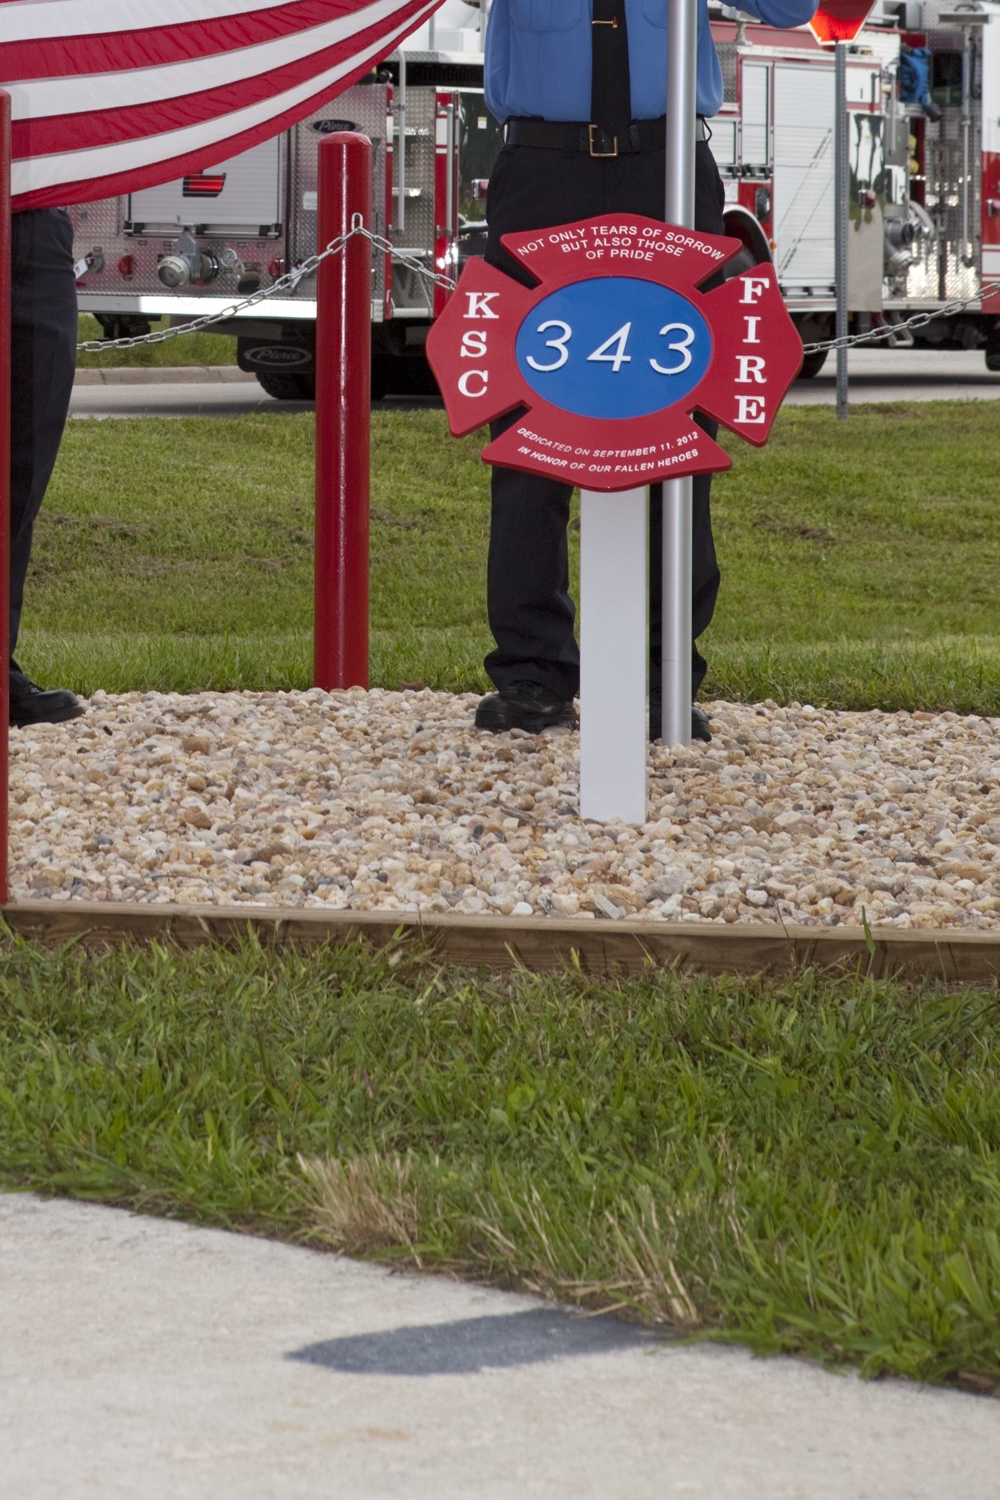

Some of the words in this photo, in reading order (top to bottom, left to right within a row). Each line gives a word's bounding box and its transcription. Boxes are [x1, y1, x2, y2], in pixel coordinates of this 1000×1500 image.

[517, 239, 545, 257] NOT
[549, 226, 586, 244] ONLY
[591, 225, 637, 236] TEARS
[642, 227, 662, 238] OF
[665, 231, 725, 260] SORROW
[561, 239, 588, 253] BUT
[594, 237, 631, 247] ALSO
[637, 238, 684, 257] THOSE
[586, 249, 605, 260] OF
[610, 249, 655, 261] PRIDE
[457, 292, 500, 397] KSC
[526, 320, 695, 375] 343
[733, 277, 769, 424] FIRE
[517, 427, 572, 453] DEDICATED
[574, 447, 590, 456] ON
[592, 446, 656, 458] SEPTEMBER
[676, 431, 699, 446] 2012
[518, 445, 531, 454] IN
[531, 450, 567, 467] HONOR
[570, 462, 586, 470] OF
[588, 464, 610, 473] OUR
[614, 462, 654, 473] FALLEN
[657, 448, 699, 468] HEROES
